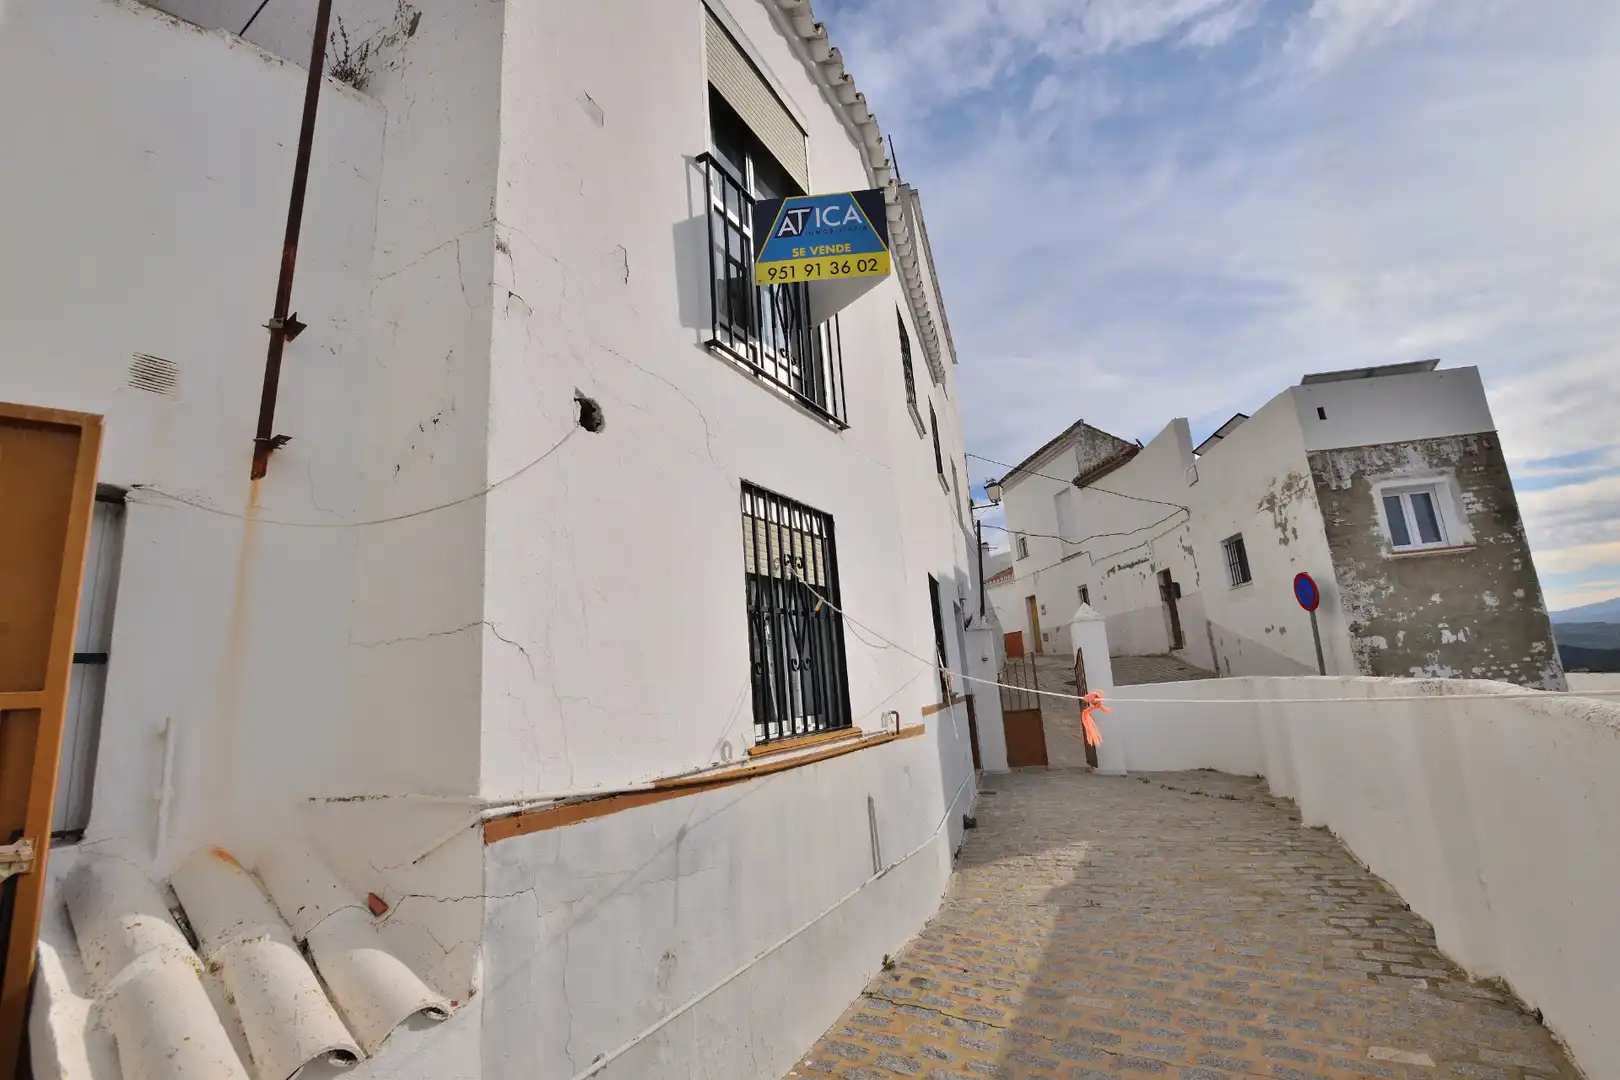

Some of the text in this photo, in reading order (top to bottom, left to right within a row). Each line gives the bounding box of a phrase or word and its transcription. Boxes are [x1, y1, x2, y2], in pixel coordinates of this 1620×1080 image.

[777, 204, 863, 237] ATICA
[792, 243, 851, 257] SE VENDE
[768, 258, 878, 281] 951 91 36 02
